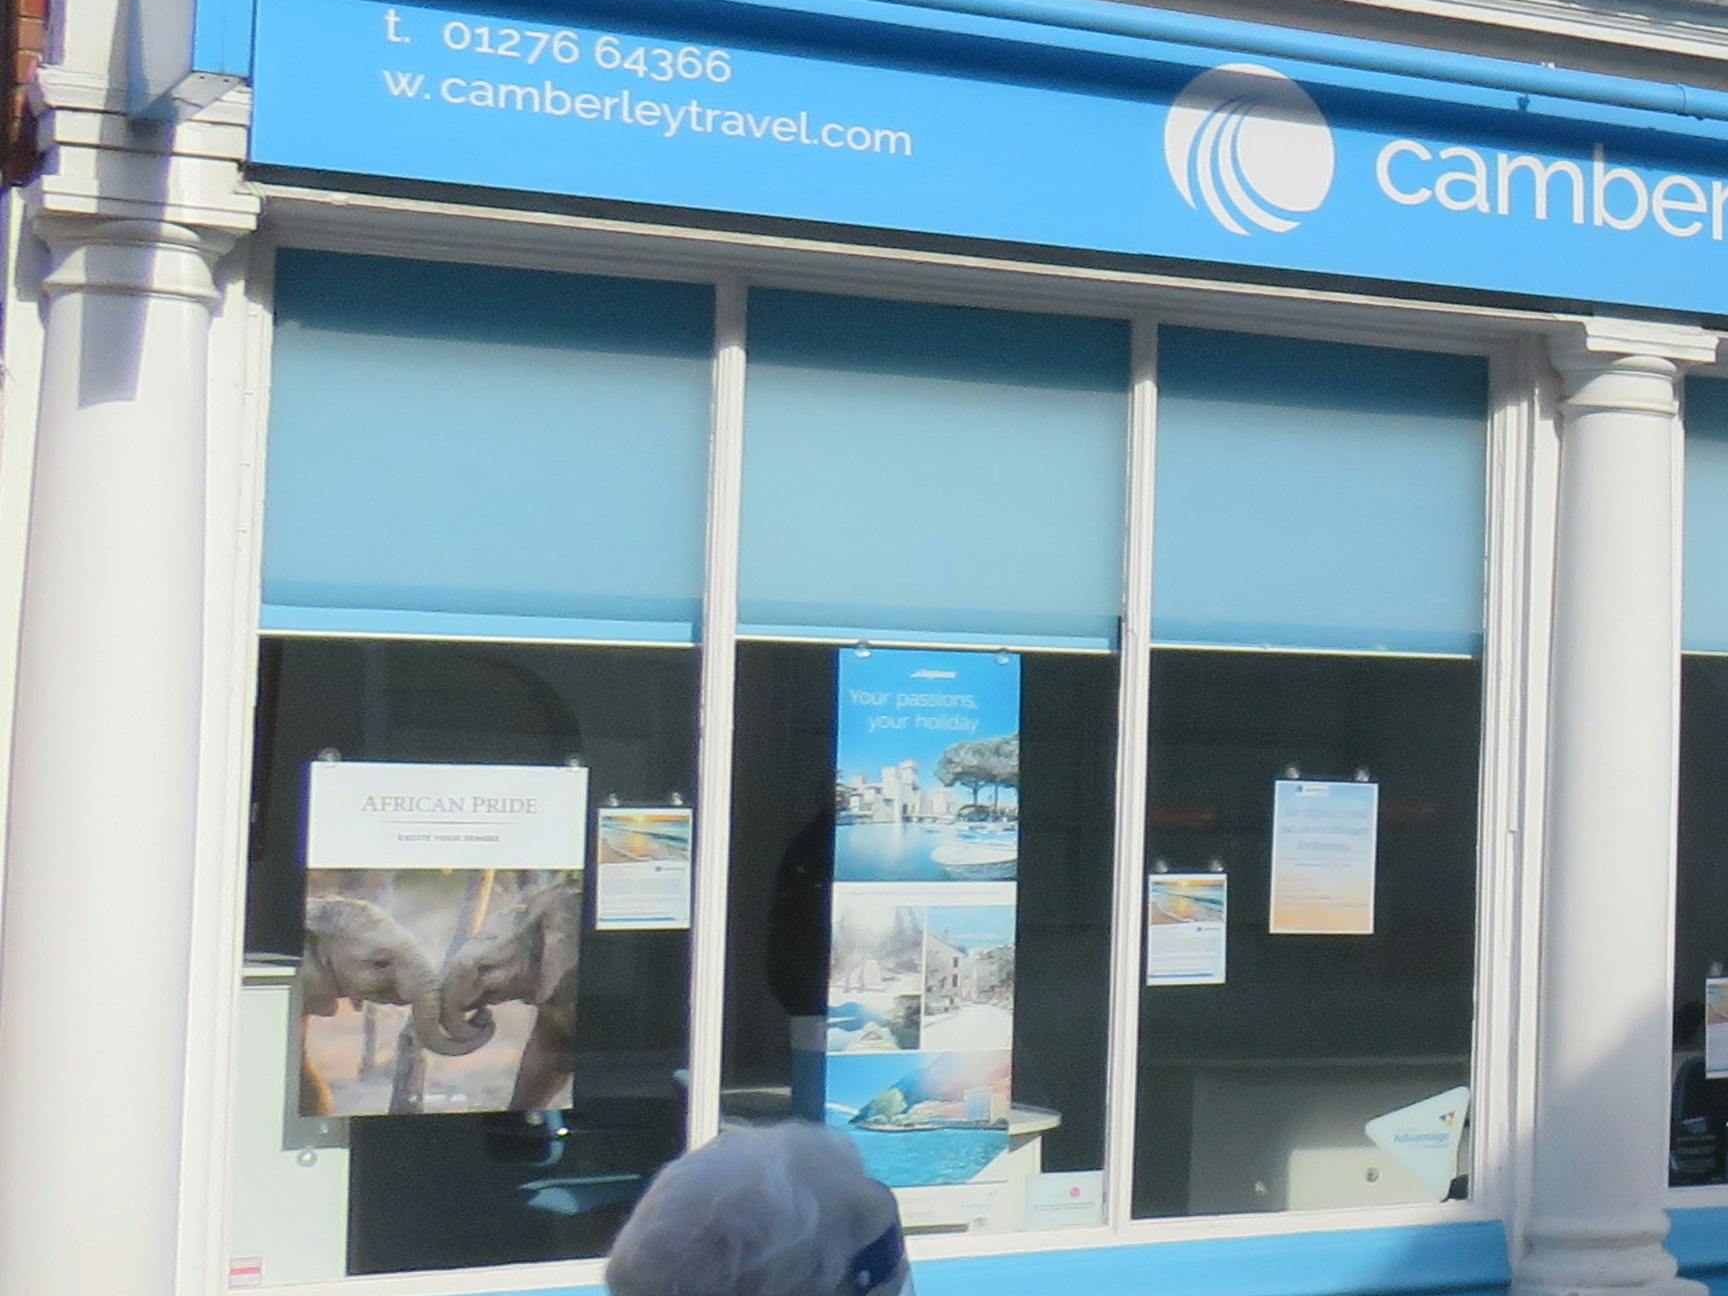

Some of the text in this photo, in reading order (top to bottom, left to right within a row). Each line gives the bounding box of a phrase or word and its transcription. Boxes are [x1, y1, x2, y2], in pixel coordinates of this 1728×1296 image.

[443, 21, 580, 64] 01276
[594, 35, 733, 83] 64366
[440, 77, 913, 156] camberleytravel.com
[850, 688, 891, 706] Your
[868, 713, 980, 733] your holiday
[361, 795, 538, 815] AFRICAN PRIDE
